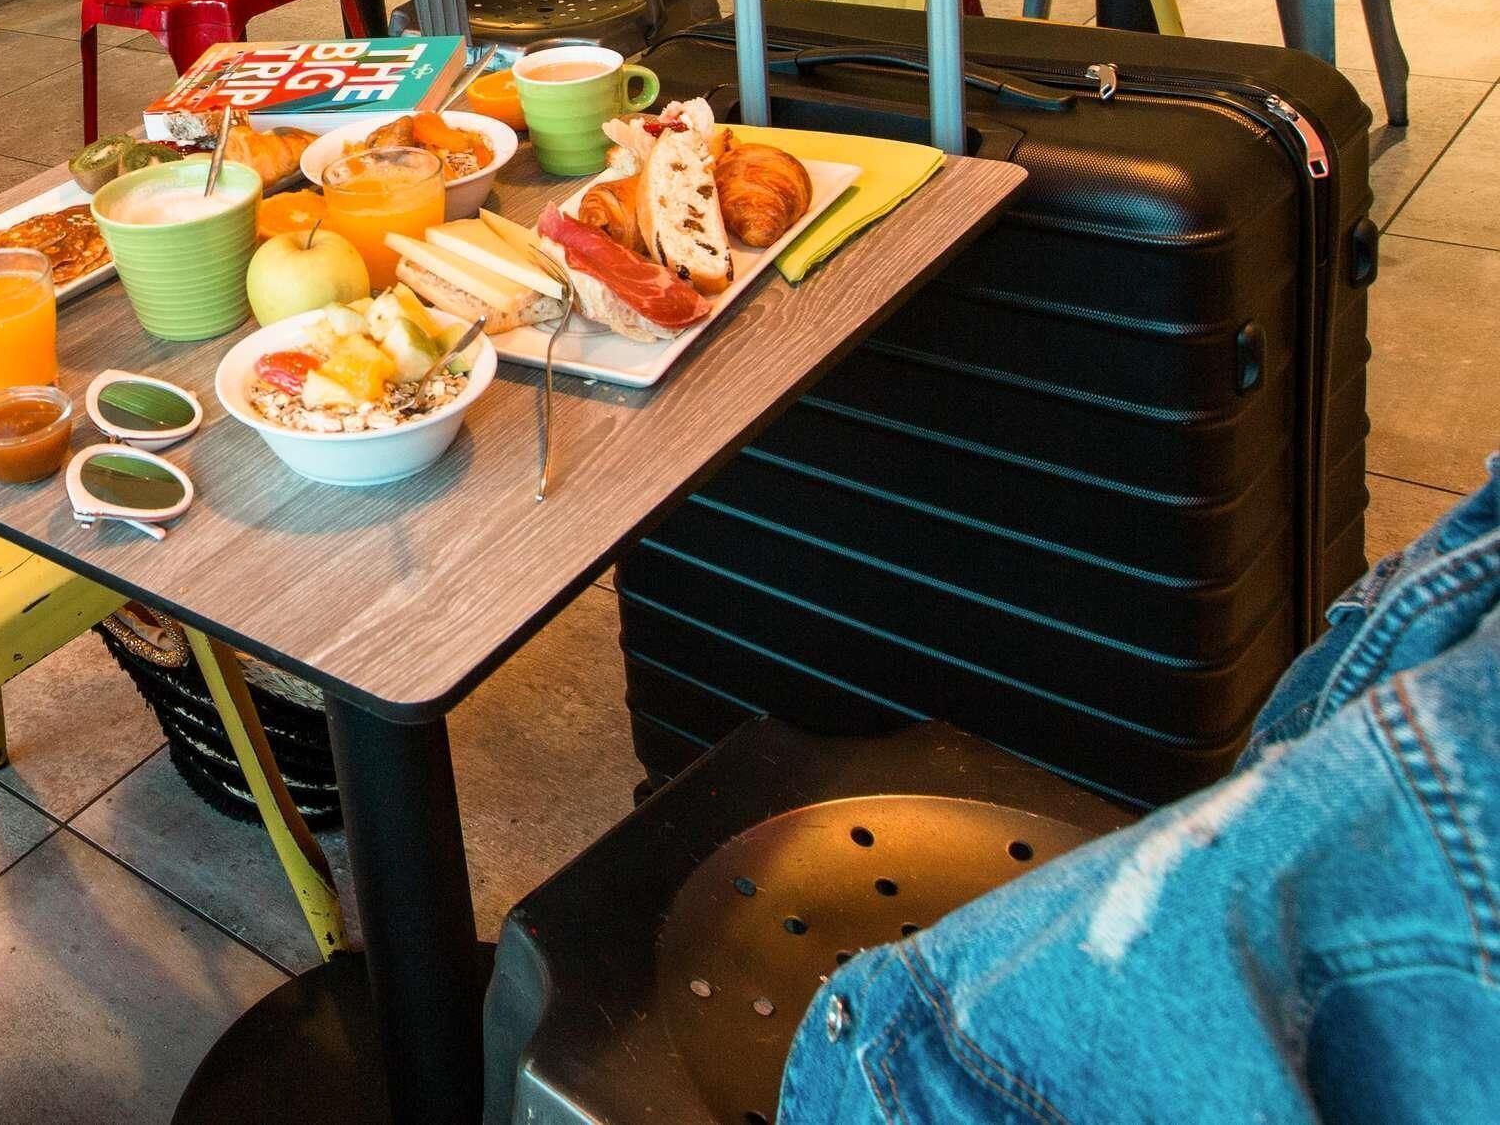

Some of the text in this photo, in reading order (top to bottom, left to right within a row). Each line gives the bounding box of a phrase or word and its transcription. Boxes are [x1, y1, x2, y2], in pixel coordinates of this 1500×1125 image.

[208, 43, 301, 107] TRIP
[284, 41, 372, 91] BIG
[331, 42, 429, 103] THE
